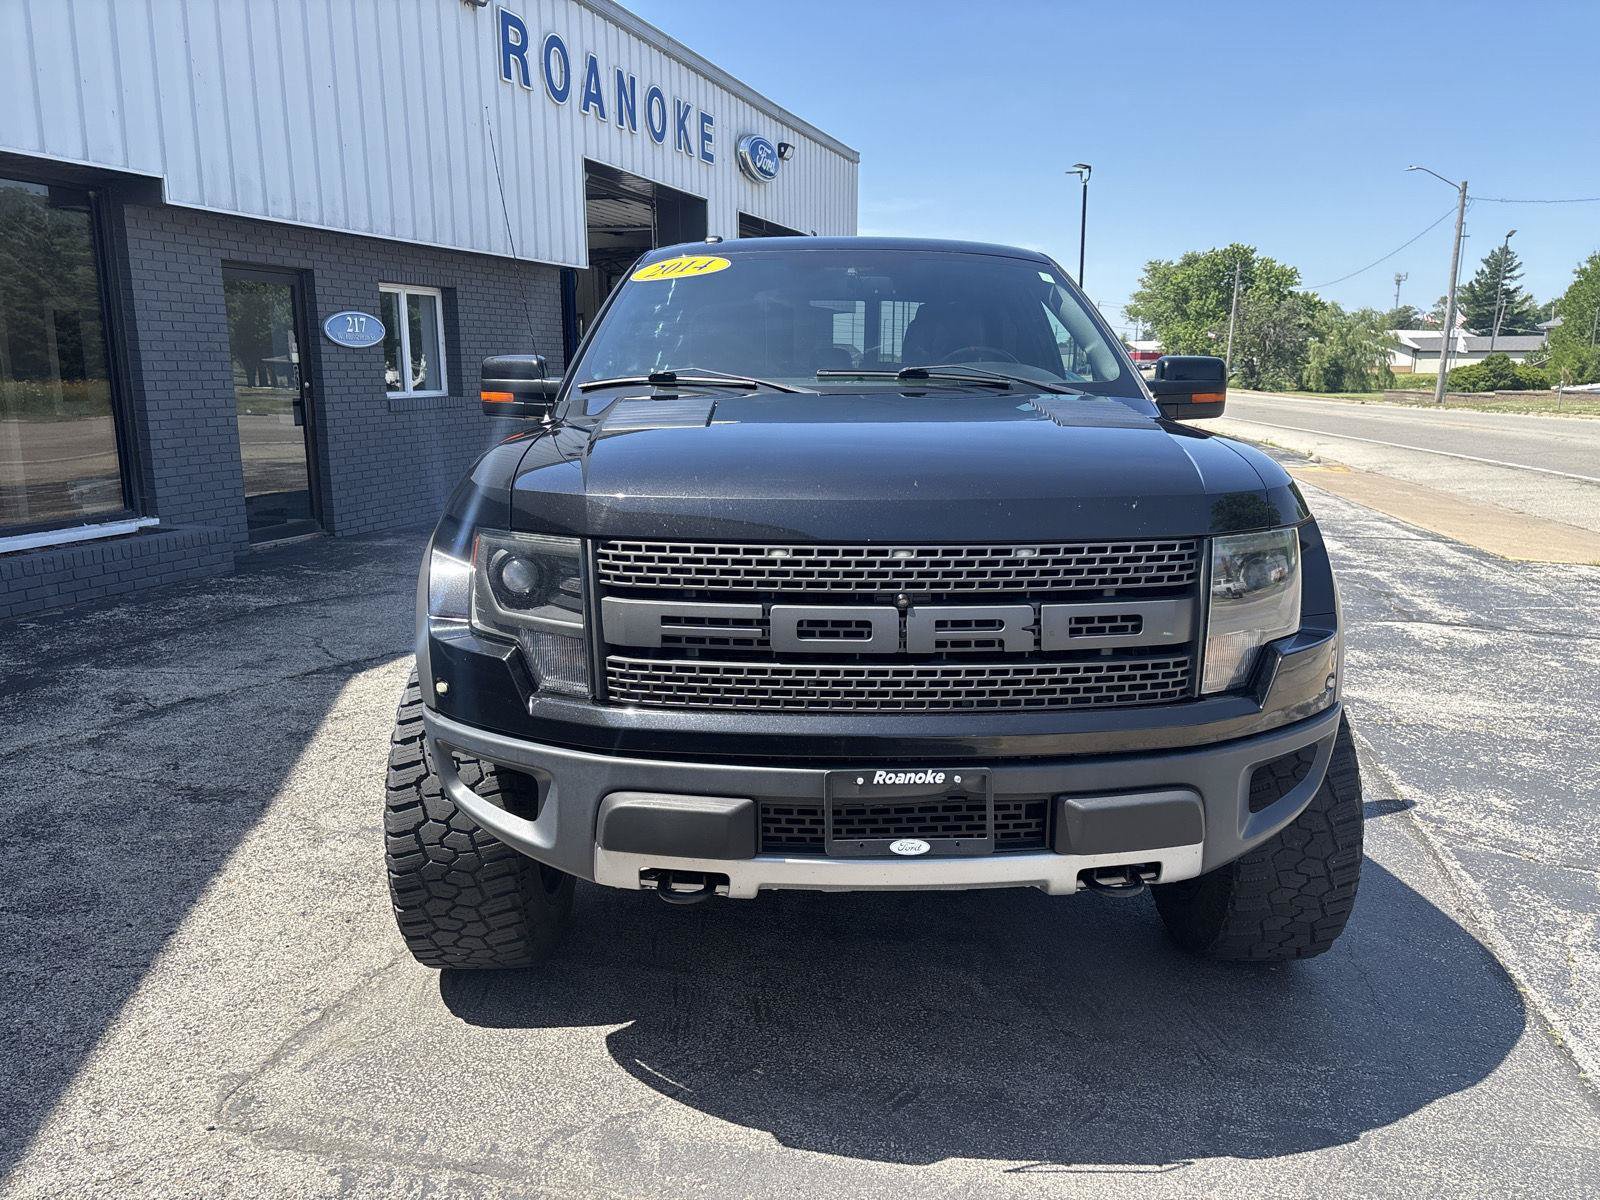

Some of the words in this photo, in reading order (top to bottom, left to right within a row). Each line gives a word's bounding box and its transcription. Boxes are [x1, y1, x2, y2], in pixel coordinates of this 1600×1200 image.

[499, 7, 716, 165] ROANOKE
[756, 144, 777, 174] Ford
[643, 259, 716, 278] 2014
[346, 316, 367, 333] 217
[601, 597, 1192, 653] FORD
[873, 769, 946, 785] Roanoke
[897, 841, 923, 852] Ford
